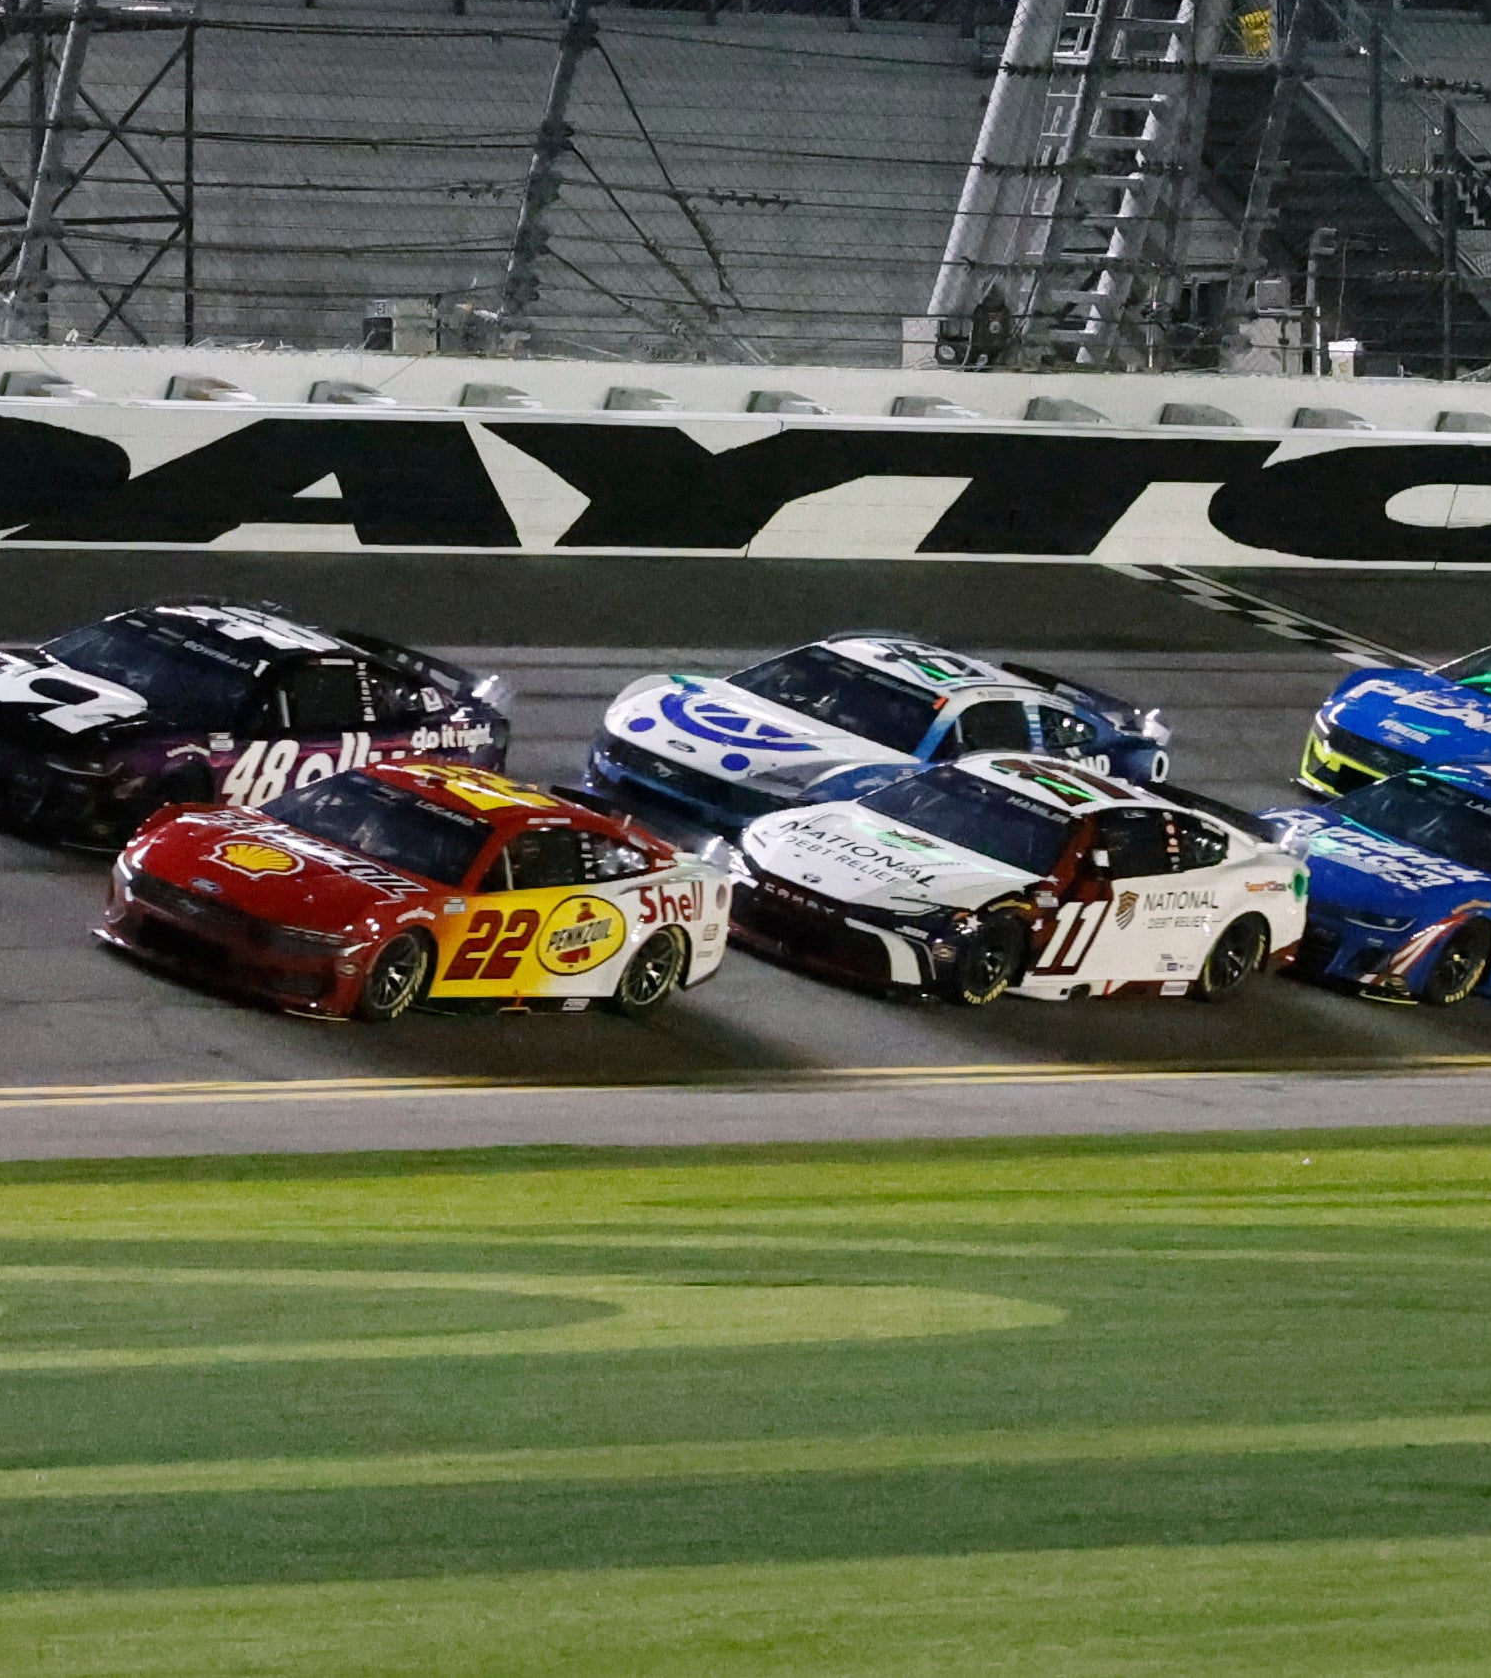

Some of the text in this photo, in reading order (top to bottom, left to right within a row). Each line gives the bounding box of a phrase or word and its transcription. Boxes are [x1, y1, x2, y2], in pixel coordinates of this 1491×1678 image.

[221, 740, 299, 812] 48
[779, 821, 937, 888] NATIONAL
[639, 881, 704, 924] Shell
[1035, 900, 1108, 969] 11
[1144, 890, 1220, 912] NATIONAL
[443, 909, 541, 981] 22
[546, 918, 612, 954] PENNZOIL
